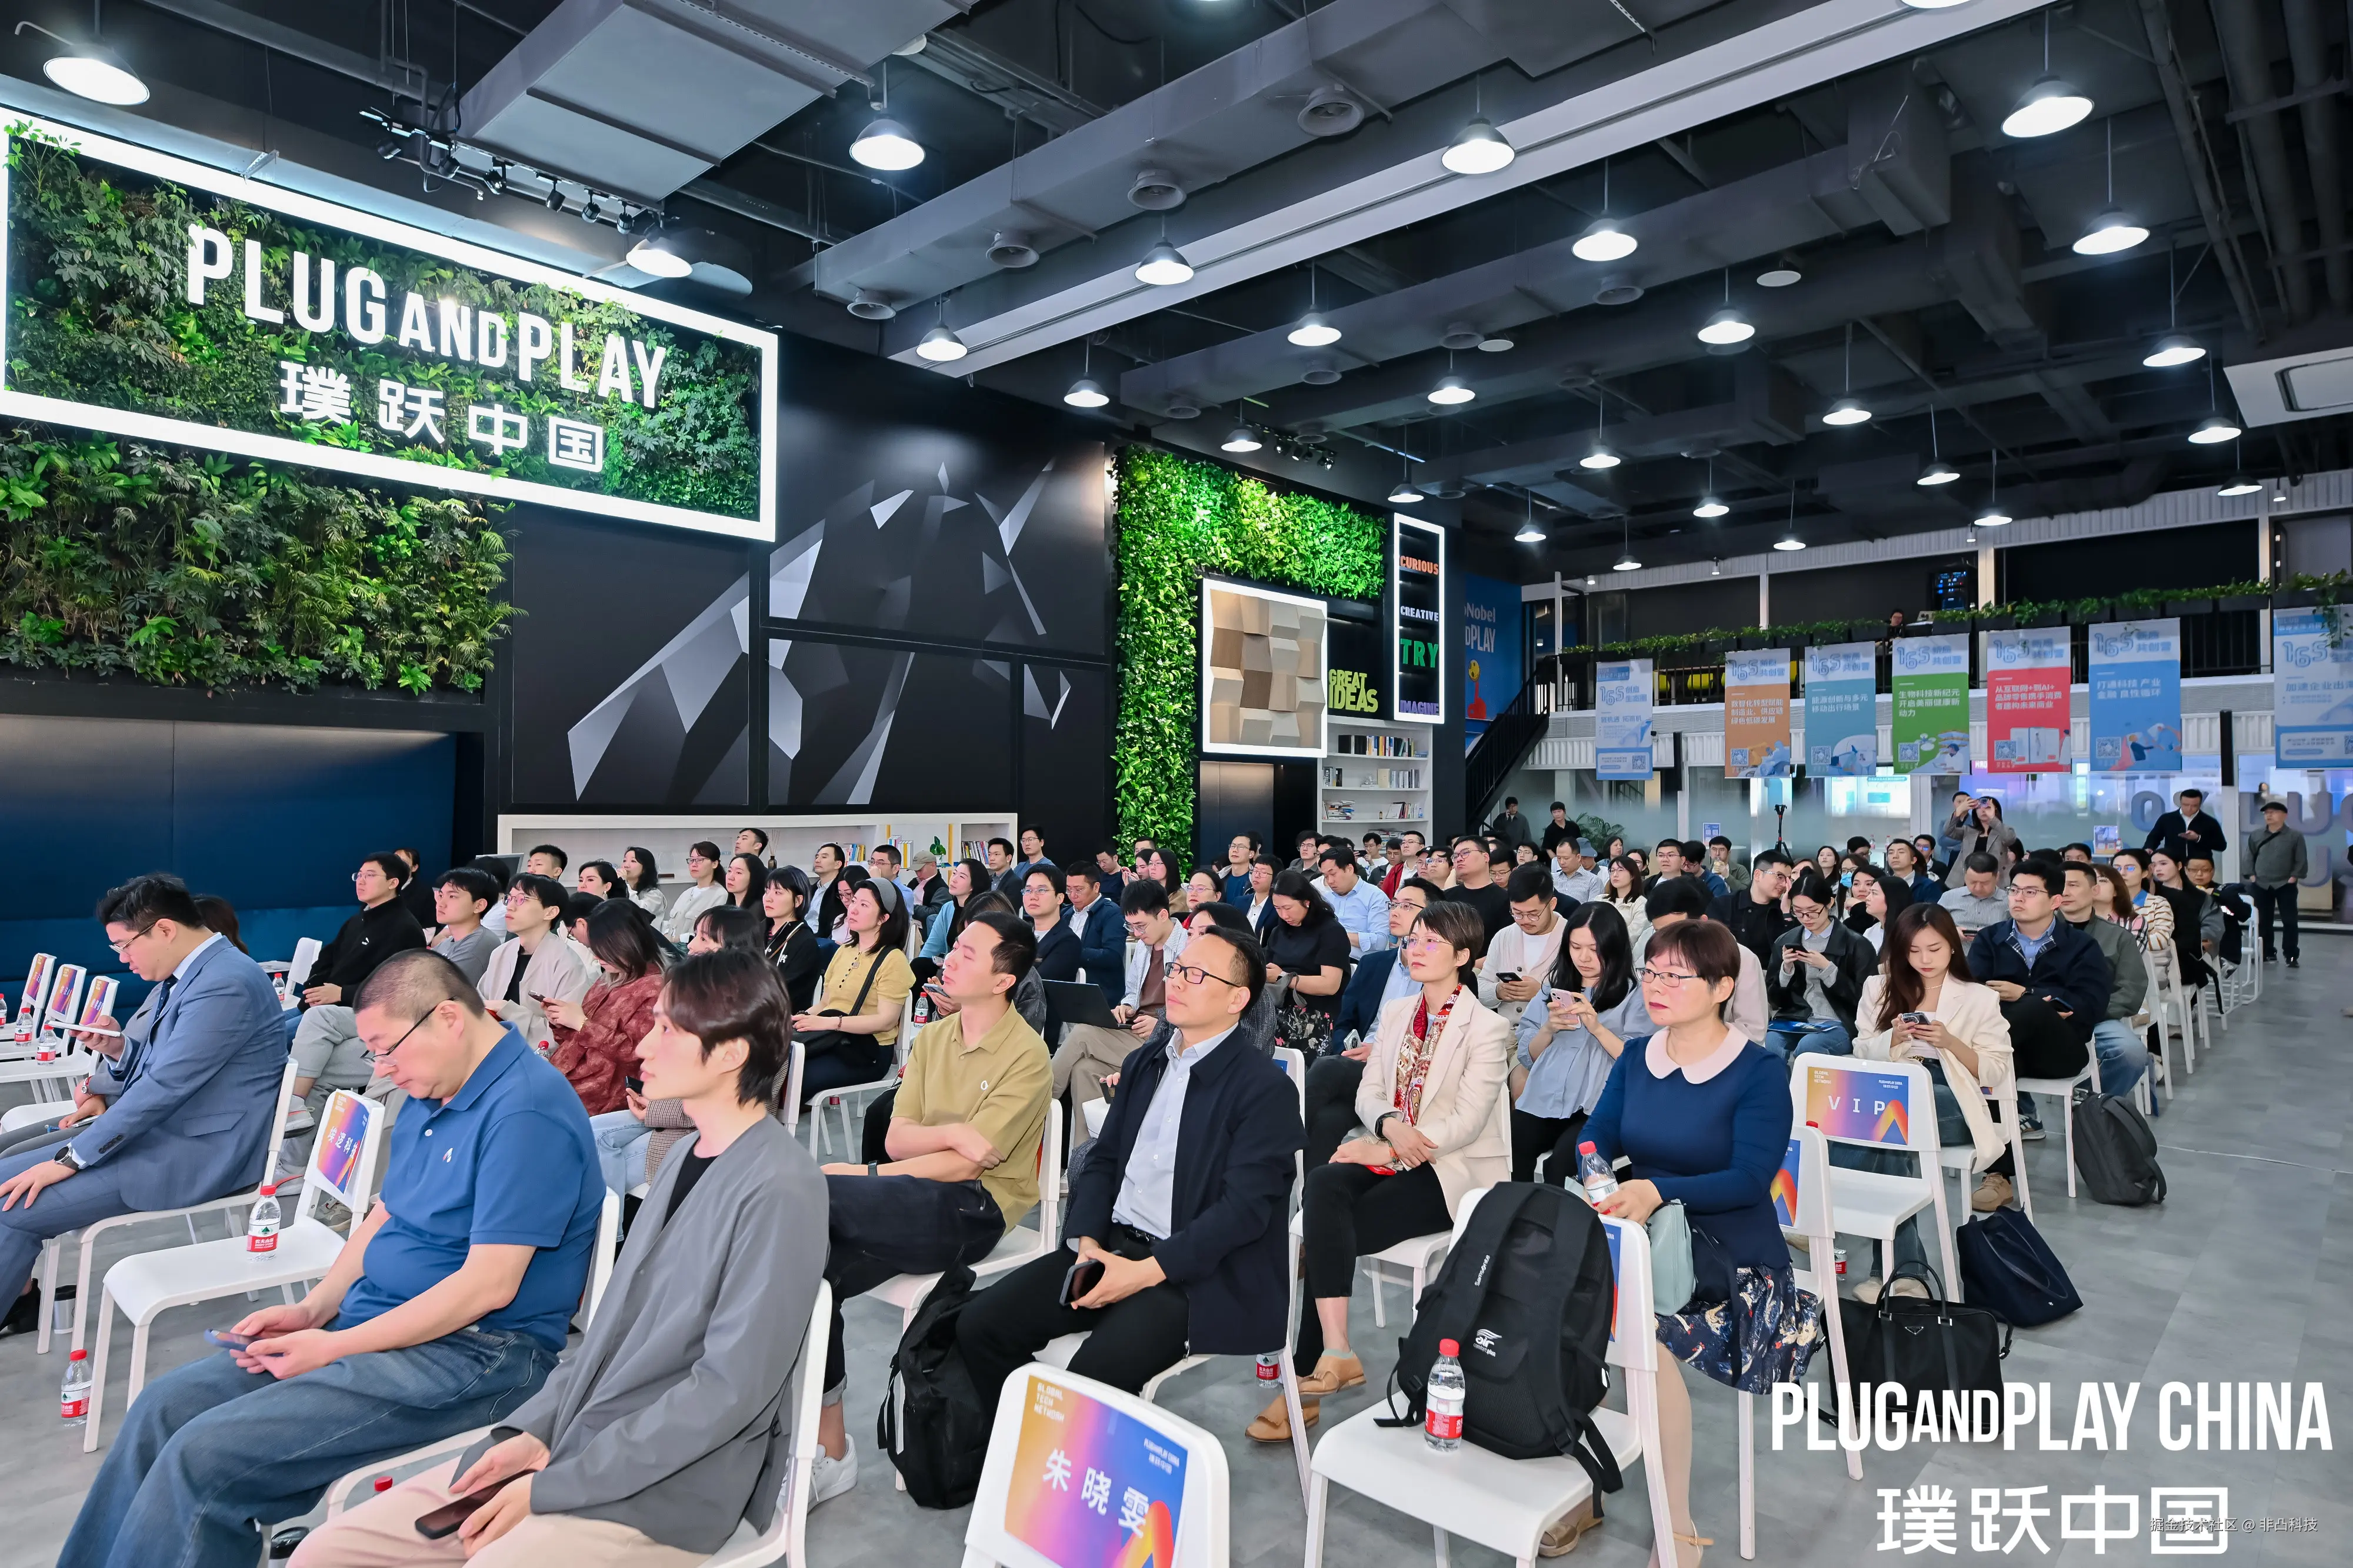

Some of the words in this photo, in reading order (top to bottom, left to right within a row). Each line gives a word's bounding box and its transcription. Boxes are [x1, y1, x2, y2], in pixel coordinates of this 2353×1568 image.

[188, 223, 666, 409] PLUGANDPLAY
[281, 361, 604, 473] 璞跃中国
[1400, 555, 1439, 576] CURIOUS
[1400, 605, 1439, 622] CREATIVE
[1400, 638, 1439, 668] TRY
[1993, 639, 2029, 663] 165
[2094, 631, 2134, 658] 165
[2282, 639, 2328, 668] 165
[1810, 653, 1841, 676] 165
[1897, 646, 1930, 669] 165
[1328, 669, 1368, 689] GREAT
[1727, 659, 1758, 681] 165
[1328, 683, 1378, 713] IDEAS
[1600, 686, 1624, 706] 165
[1899, 688, 1960, 699] 生物科技新纪元
[1400, 700, 1439, 716] IMAGINE
[1899, 709, 1916, 718] 动力
[1828, 1095, 1885, 1115] VIP
[1475, 1336, 1495, 1348] air
[1036, 1392, 1054, 1407] TECH
[1037, 1383, 1064, 1402] GLOBAL
[1043, 1447, 1150, 1539] 朱晓雯
